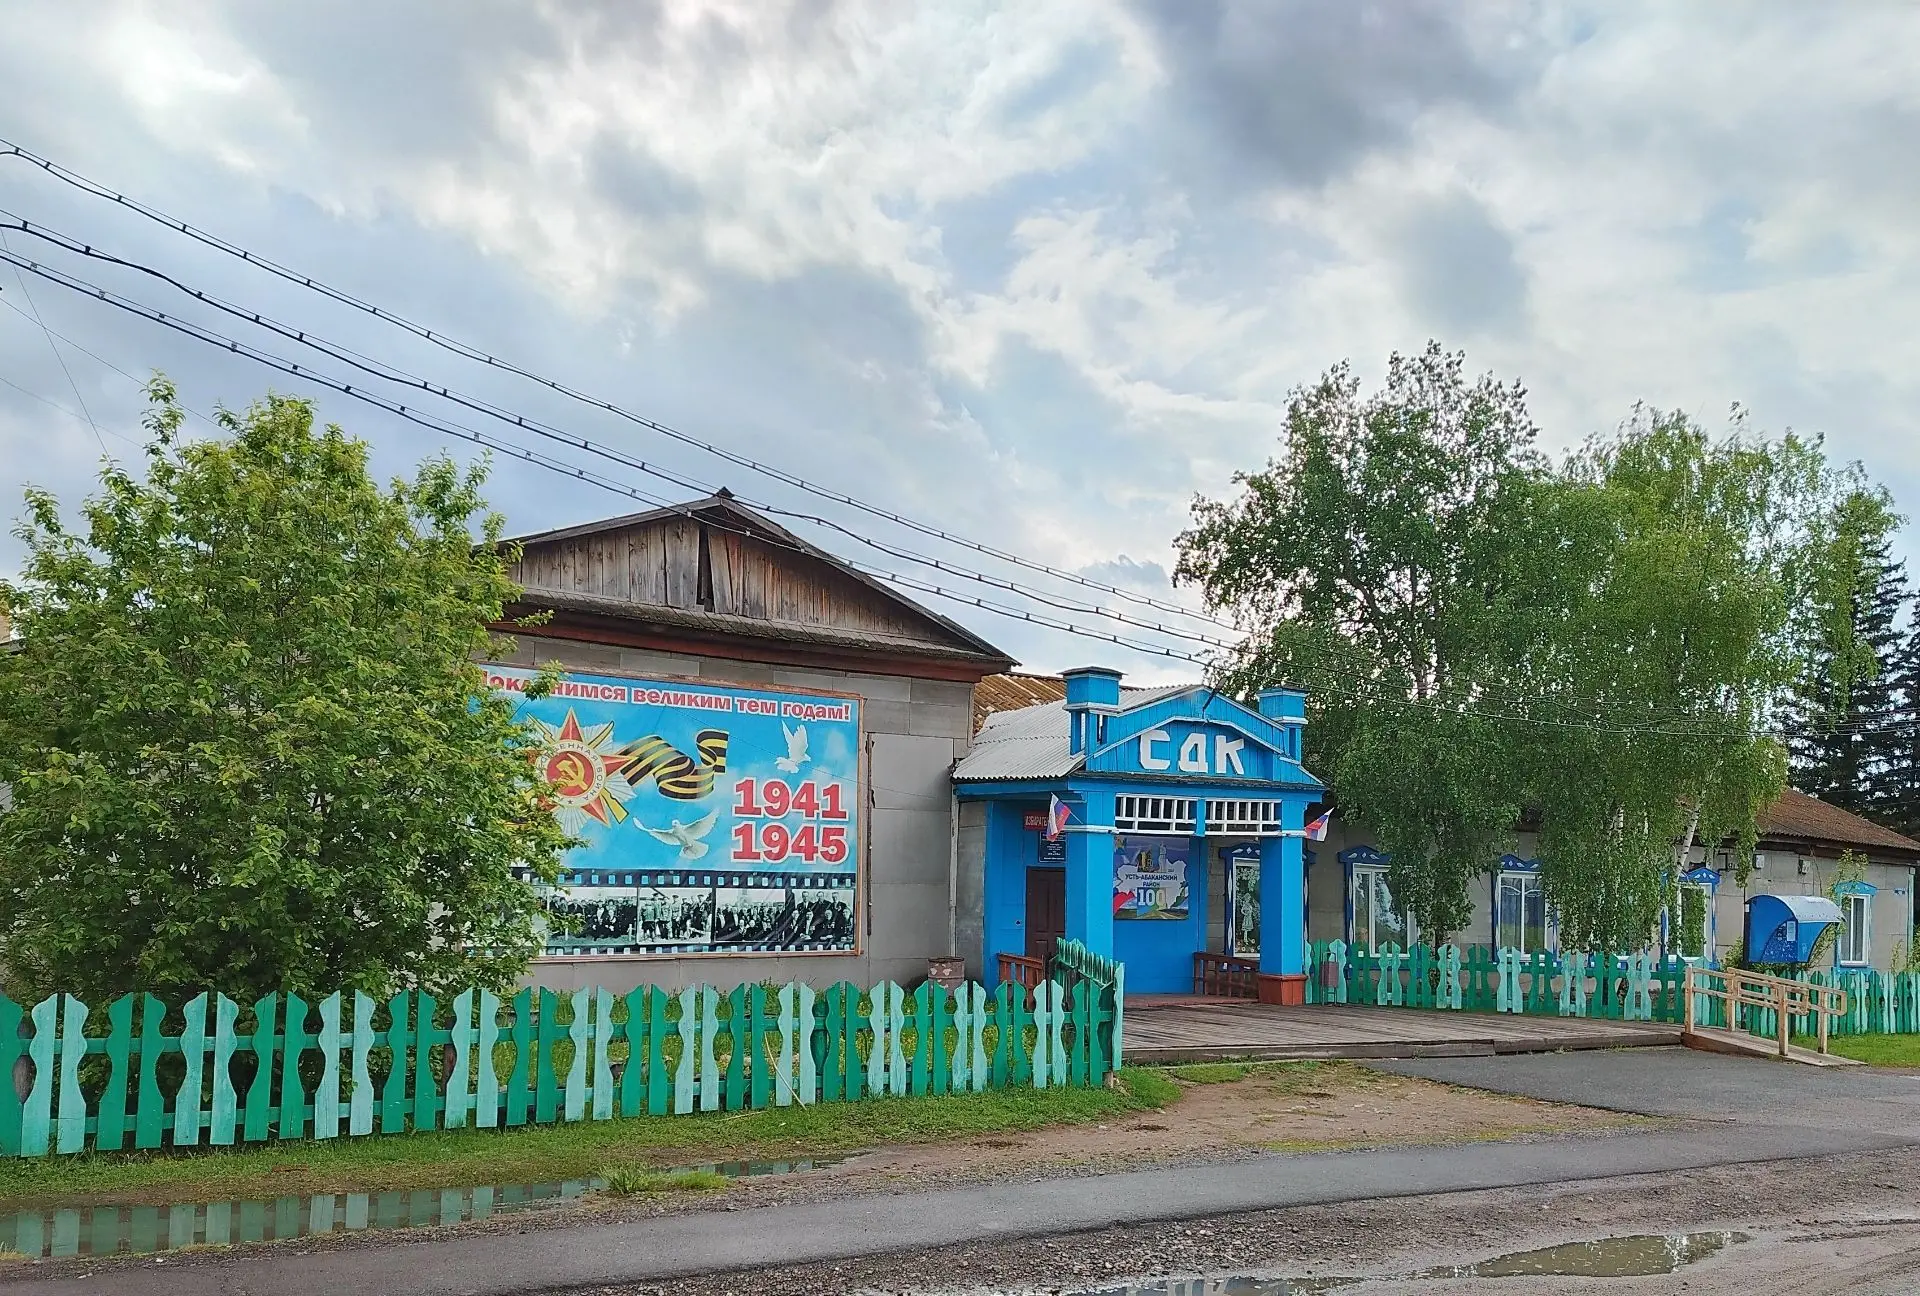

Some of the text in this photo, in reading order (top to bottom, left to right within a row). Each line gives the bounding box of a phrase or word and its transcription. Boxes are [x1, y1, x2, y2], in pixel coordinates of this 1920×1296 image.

[481, 671, 851, 721] оклнимся великим тем годам!
[1140, 729, 1245, 775] СДК
[583, 767, 603, 801] ВОЙНА
[734, 779, 847, 819] 1941
[733, 823, 846, 862] 1945
[1125, 873, 1178, 881] УСТЬ-АБАКАНСКИЙ
[1137, 888, 1167, 908] 100
